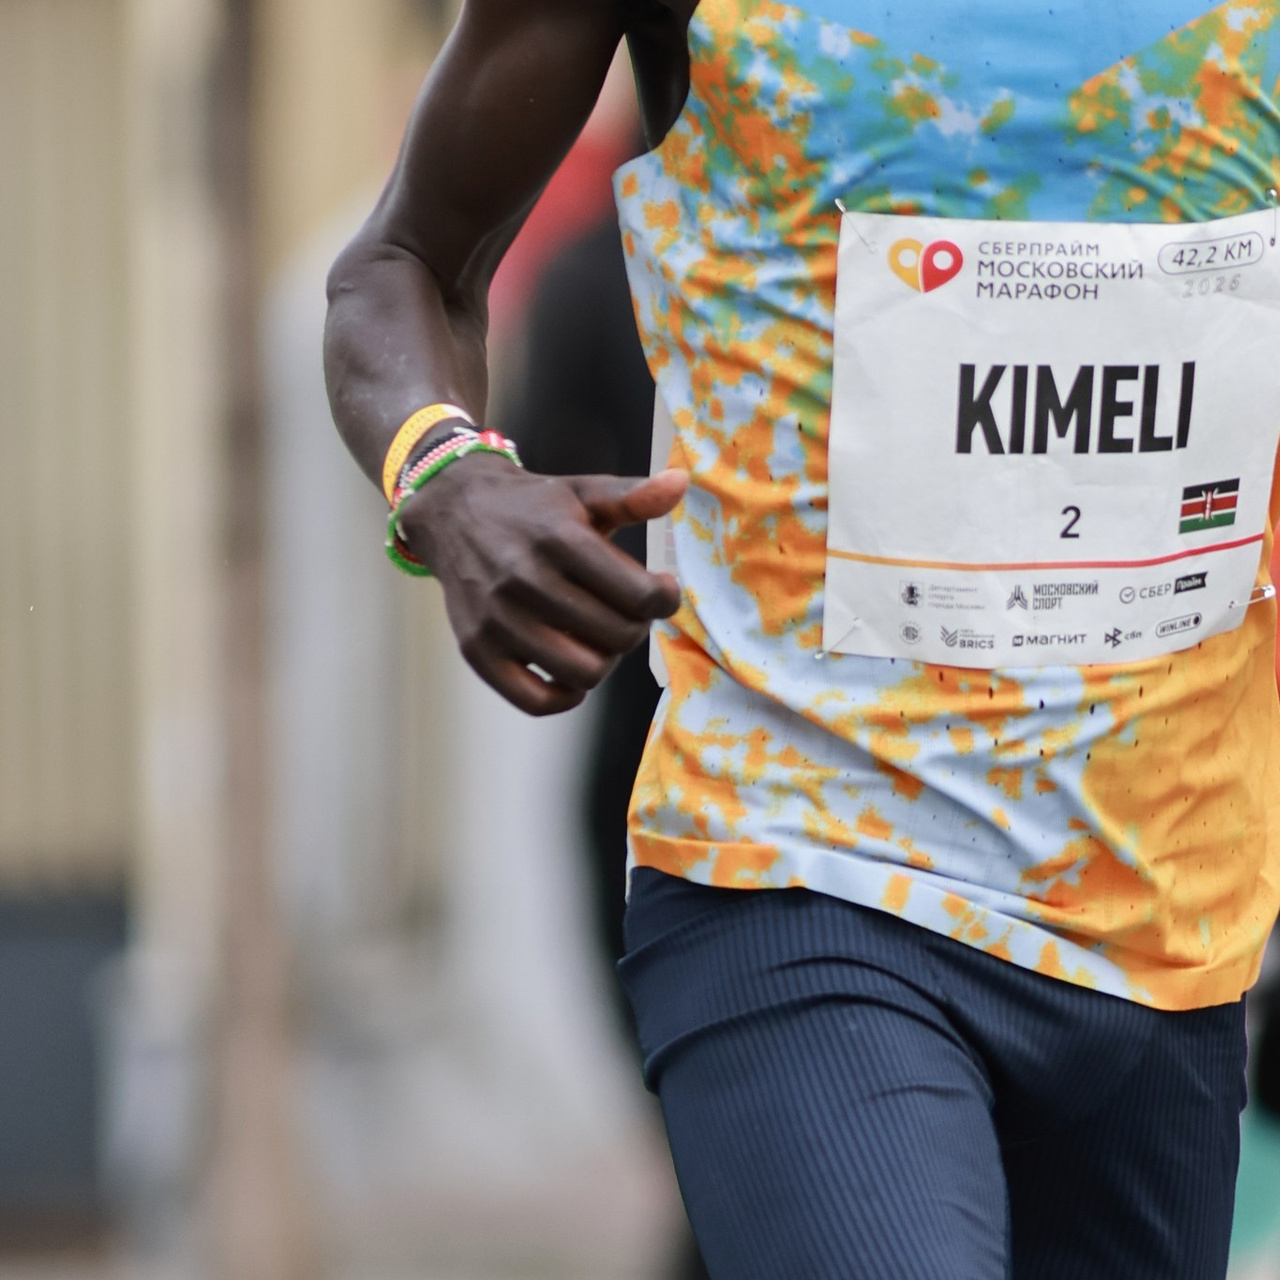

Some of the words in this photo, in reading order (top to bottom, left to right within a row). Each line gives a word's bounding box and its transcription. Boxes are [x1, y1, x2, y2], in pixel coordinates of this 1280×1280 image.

[978, 240, 1100, 256] СБЕРПРАЙМ
[1172, 246, 1217, 267] 42,2
[977, 259, 1144, 279] МОСКОВСКИЙ
[976, 281, 1099, 300] МАРАФОН
[955, 361, 1196, 455] KIMELI
[1060, 505, 1081, 538] 2
[1032, 579, 1099, 597] МОСКОВСКИЙ
[1139, 583, 1172, 599] СБЕР
[1032, 597, 1063, 610] СПОРТ
[959, 639, 994, 649] BRICS
